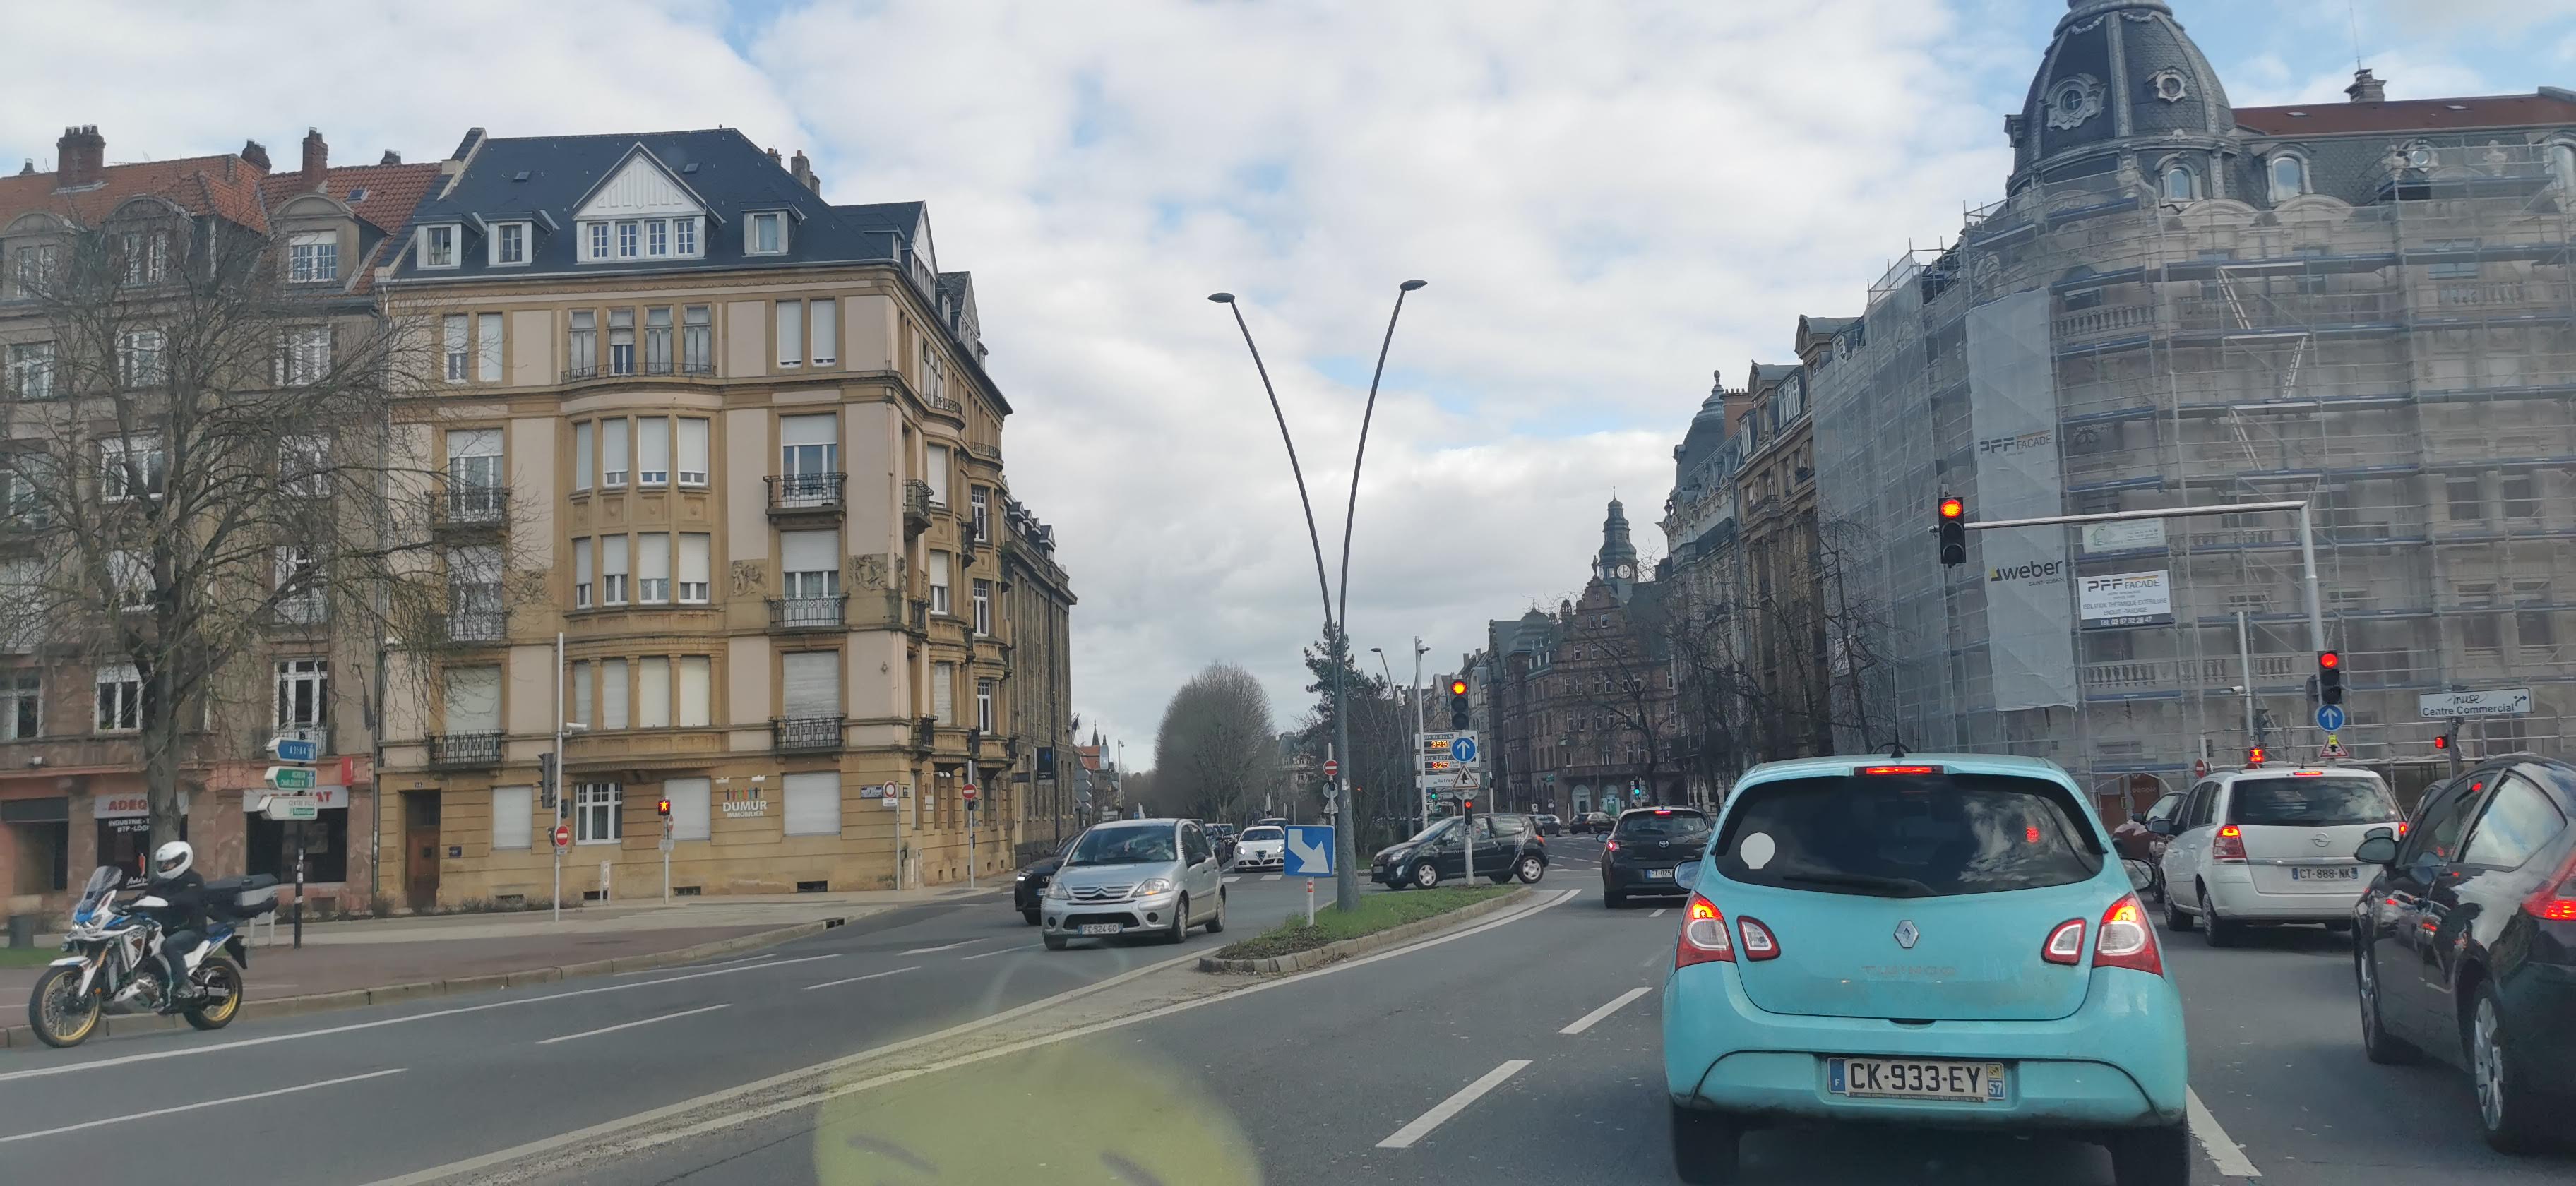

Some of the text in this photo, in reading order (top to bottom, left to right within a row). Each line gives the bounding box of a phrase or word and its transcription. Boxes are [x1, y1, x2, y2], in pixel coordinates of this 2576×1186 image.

[1979, 434, 2051, 455] PFF FACADE
[2002, 560, 2063, 580] weber
[2087, 578, 2160, 592] PFF FACADE
[2422, 703, 2515, 717] Centre Commercial
[108, 799, 148, 811] ADEQ
[722, 800, 768, 812] DUMUR
[727, 810, 764, 818] IMMOBILIER
[1850, 1062, 1981, 1093] CK-933-EY
[1988, 1082, 2003, 1095] 57
